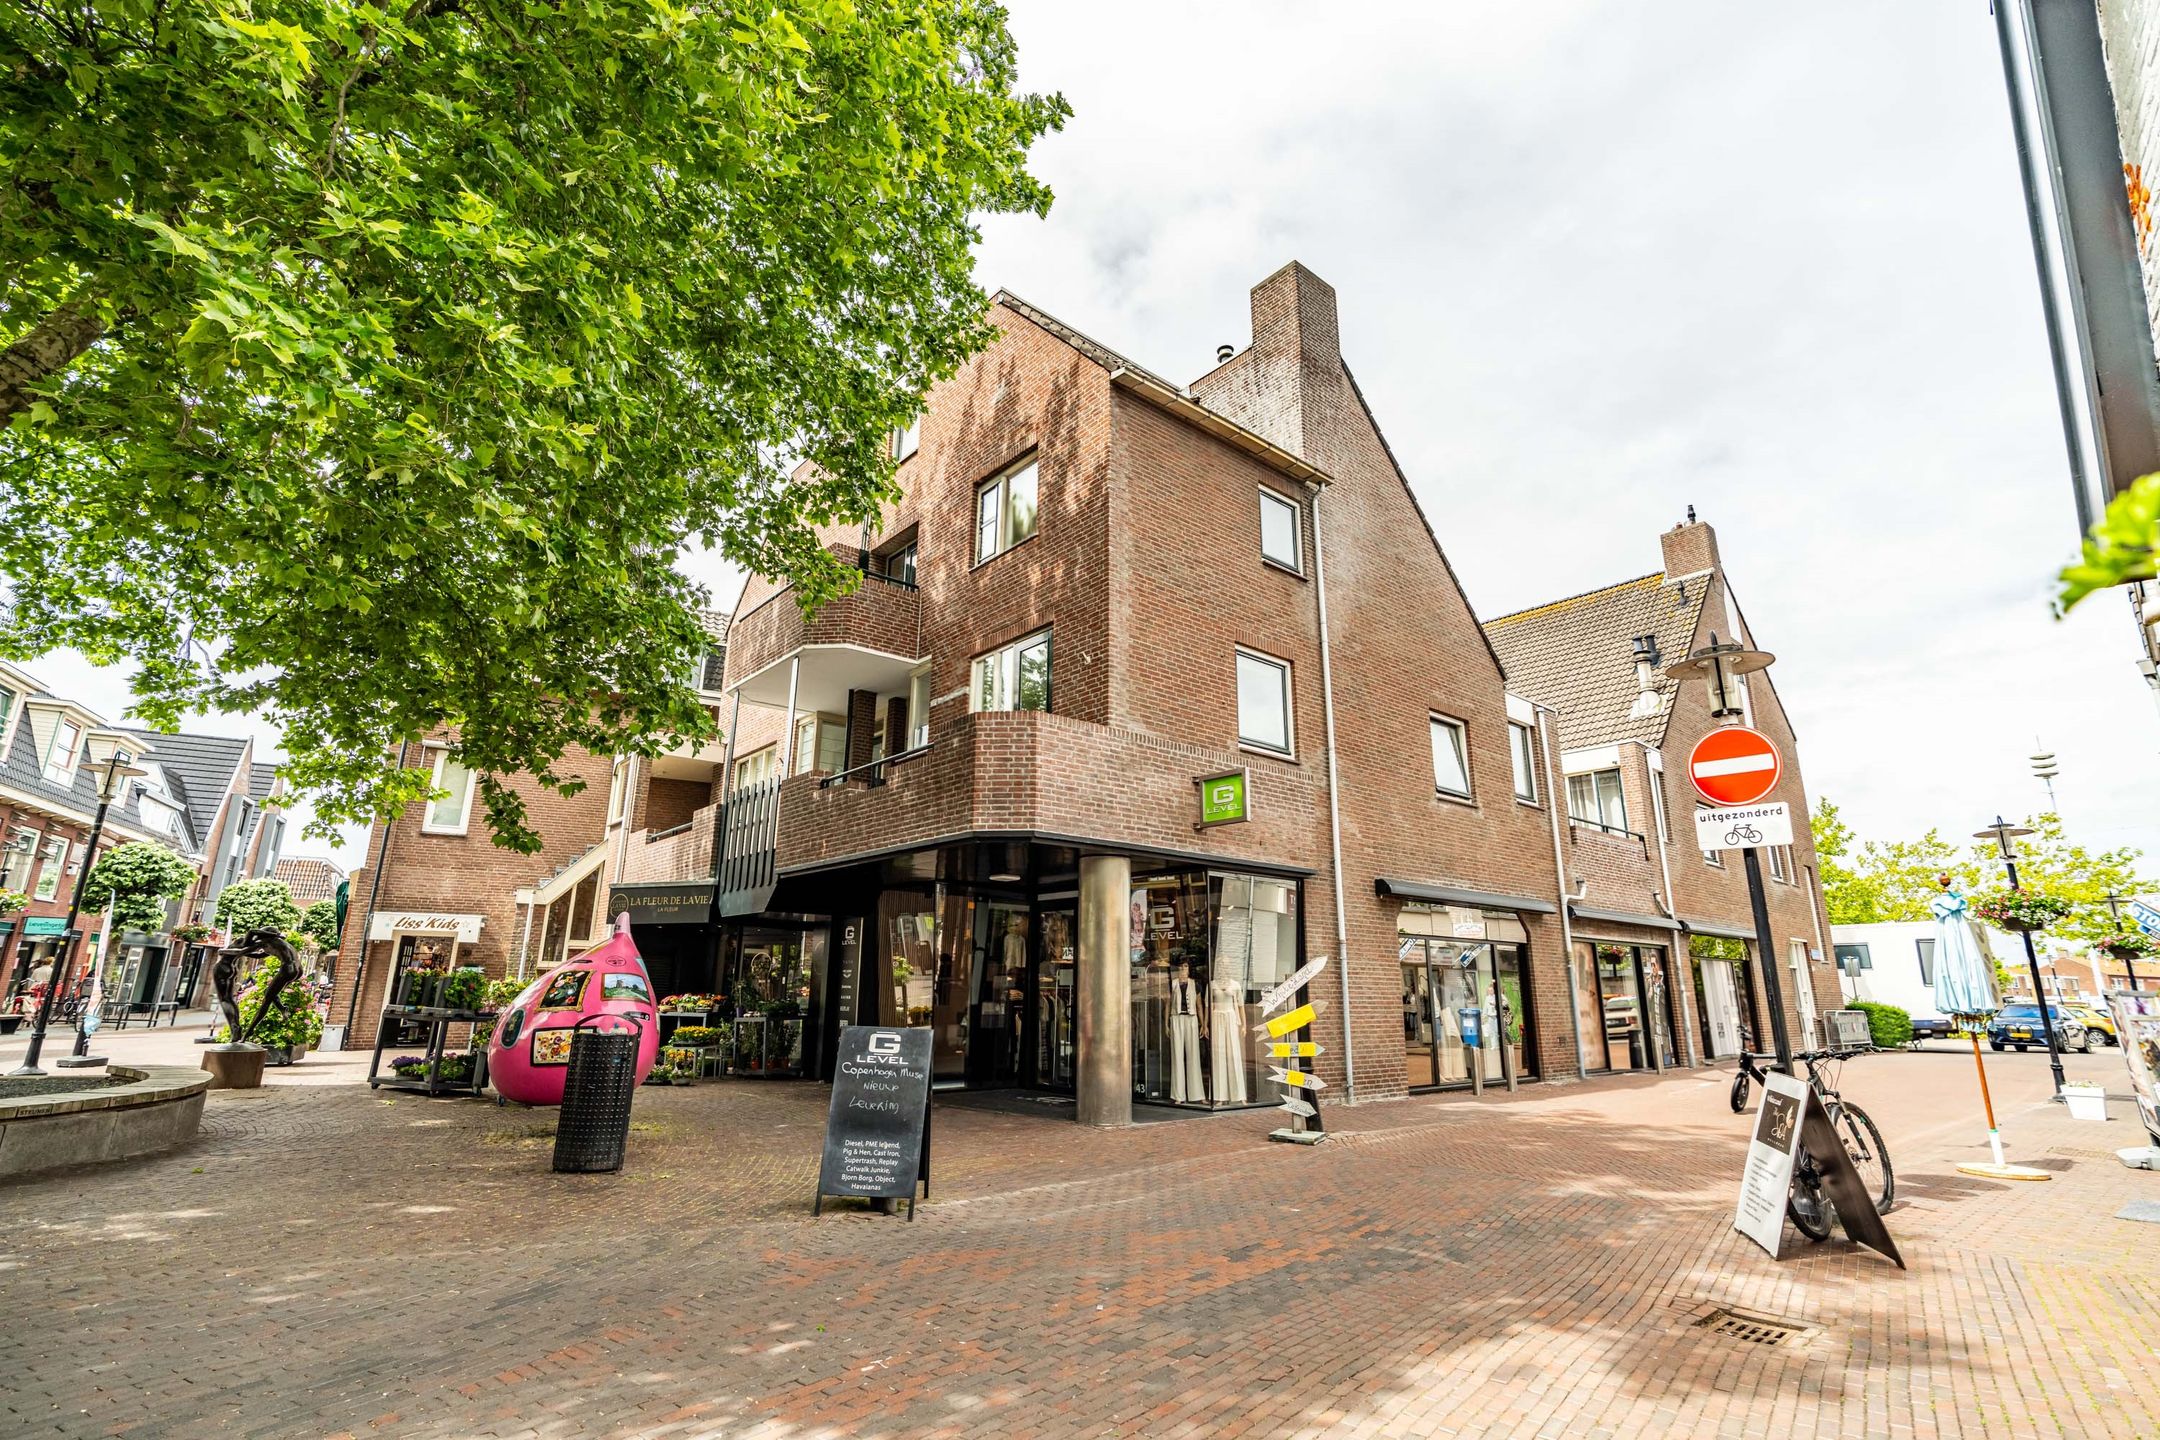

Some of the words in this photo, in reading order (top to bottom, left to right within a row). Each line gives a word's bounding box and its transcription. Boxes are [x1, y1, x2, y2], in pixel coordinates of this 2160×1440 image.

[1207, 803, 1241, 814] LEVEL
[1700, 807, 1783, 823] uitgezonderd
[630, 898, 641, 906] LA
[642, 896, 669, 906] FLEUR
[670, 896, 681, 905] DE
[868, 1032, 901, 1055] G
[856, 1055, 909, 1065] LEVEL
[841, 1062, 897, 1079] Copenhagen
[900, 1067, 924, 1080] Muse
[1135, 1083, 1146, 1094] 43
[843, 1148, 852, 1156] Pig
[851, 1183, 881, 1191] Havaianas
